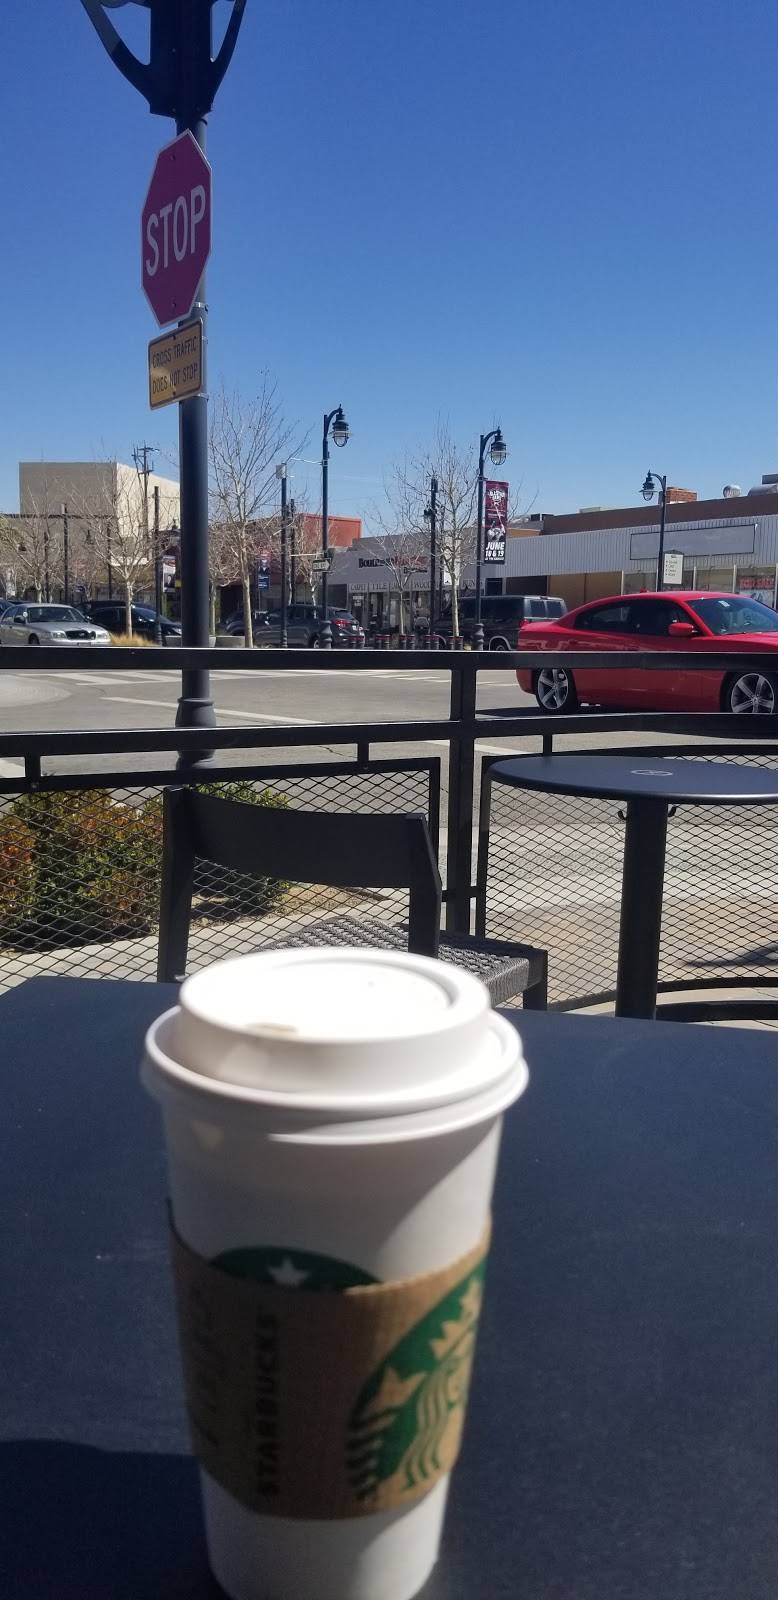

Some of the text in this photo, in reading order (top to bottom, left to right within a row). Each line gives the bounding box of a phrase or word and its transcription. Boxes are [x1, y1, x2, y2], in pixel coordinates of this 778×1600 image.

[145, 184, 206, 276] STOP
[152, 335, 198, 369] CROSS TRAFFIC
[152, 362, 198, 394] DOES NOT STOP
[485, 541, 505, 551] JUNE
[372, 582, 388, 590] TILE
[254, 1312, 280, 1498] STARBUCKS
